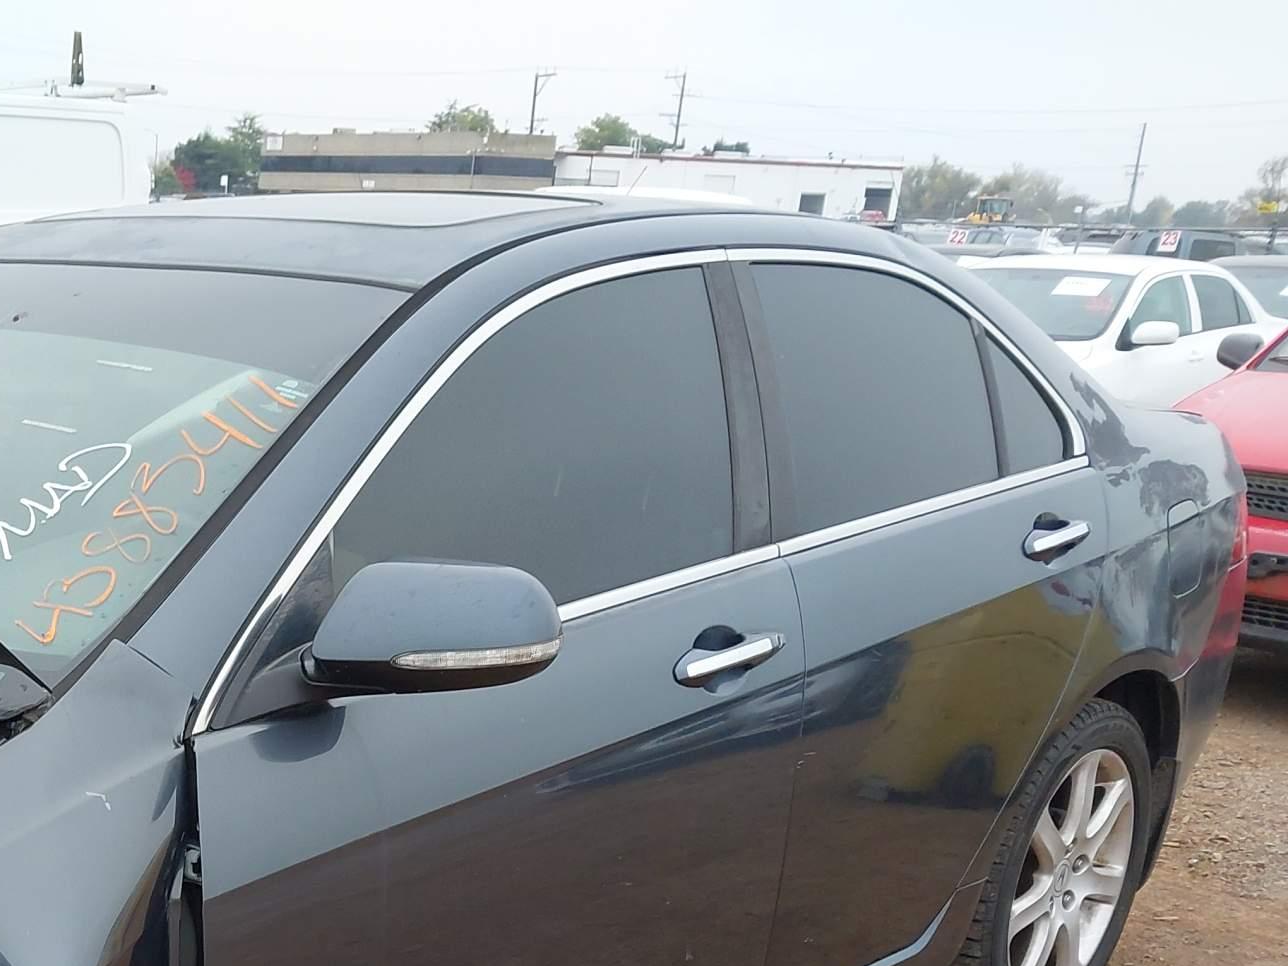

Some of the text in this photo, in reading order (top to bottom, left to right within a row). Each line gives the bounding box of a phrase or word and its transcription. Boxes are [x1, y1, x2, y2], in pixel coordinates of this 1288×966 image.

[949, 230, 967, 246] 22
[1161, 231, 1178, 247] 23
[15, 375, 299, 645] 43883411
